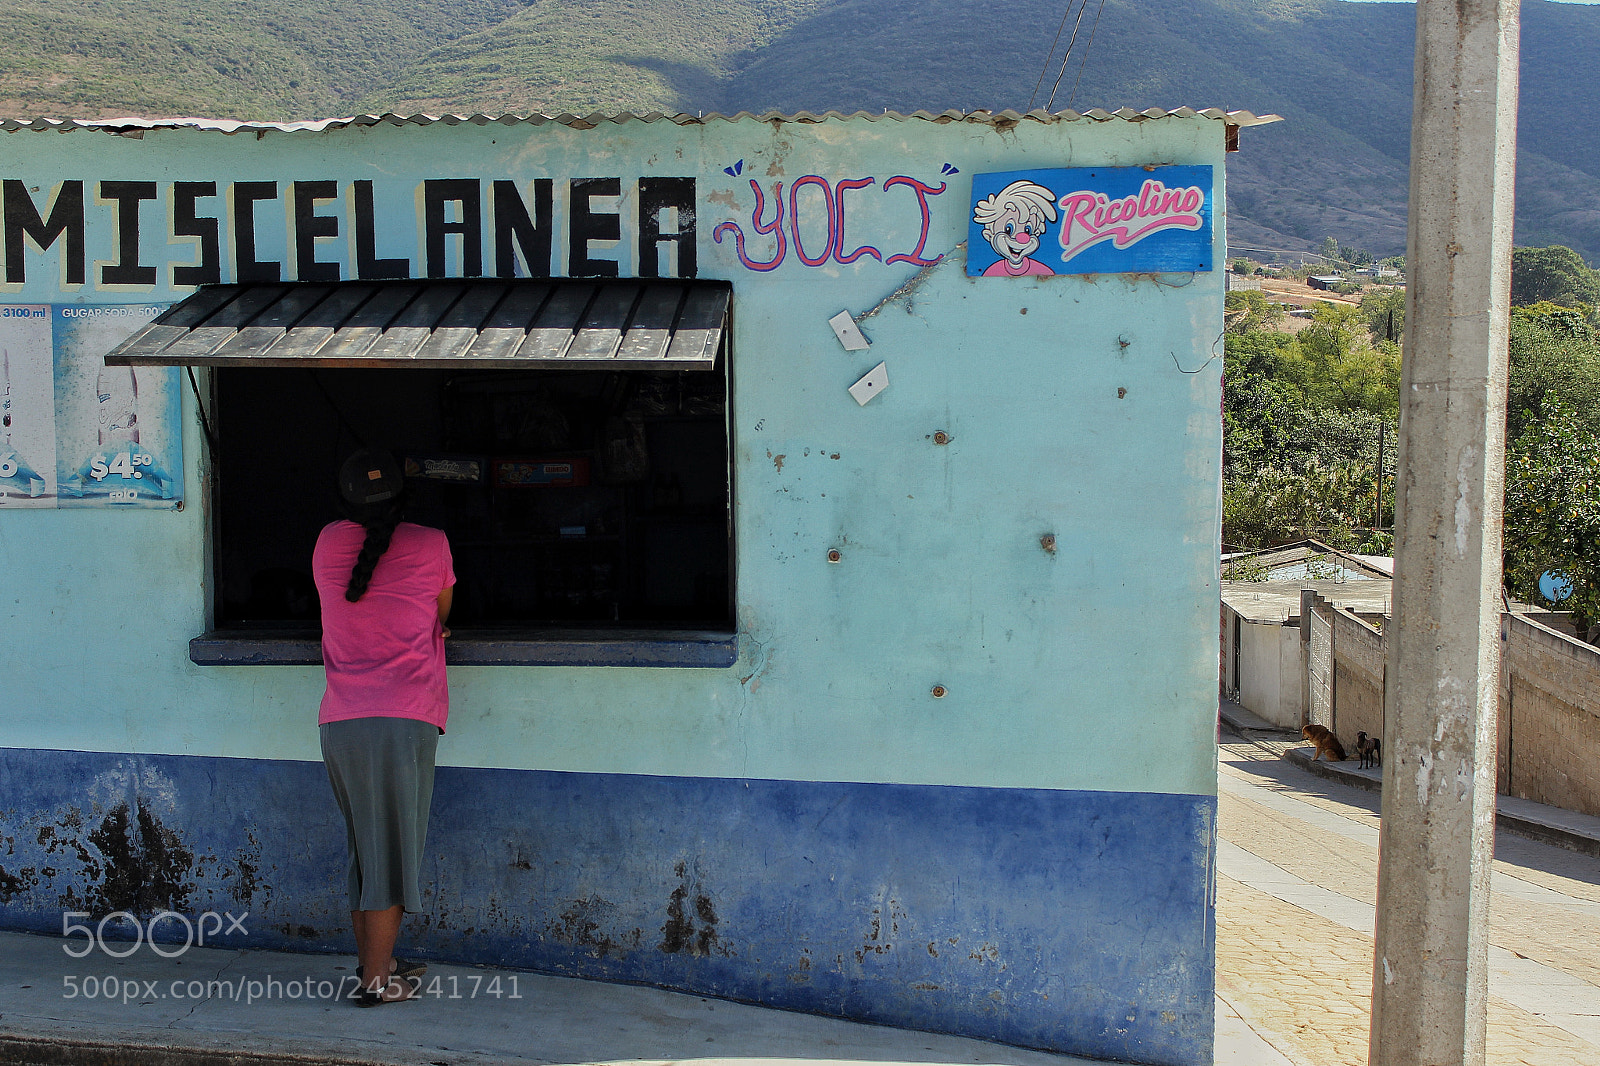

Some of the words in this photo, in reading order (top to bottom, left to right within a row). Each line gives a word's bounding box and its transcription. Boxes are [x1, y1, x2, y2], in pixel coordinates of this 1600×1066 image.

[3, 176, 698, 285] MISCELANEA
[1060, 181, 1201, 247] Ricolino
[2, 307, 31, 318] 3100
[32, 307, 46, 318] ml
[62, 308, 102, 318] GUGAR
[104, 308, 135, 318] SODA
